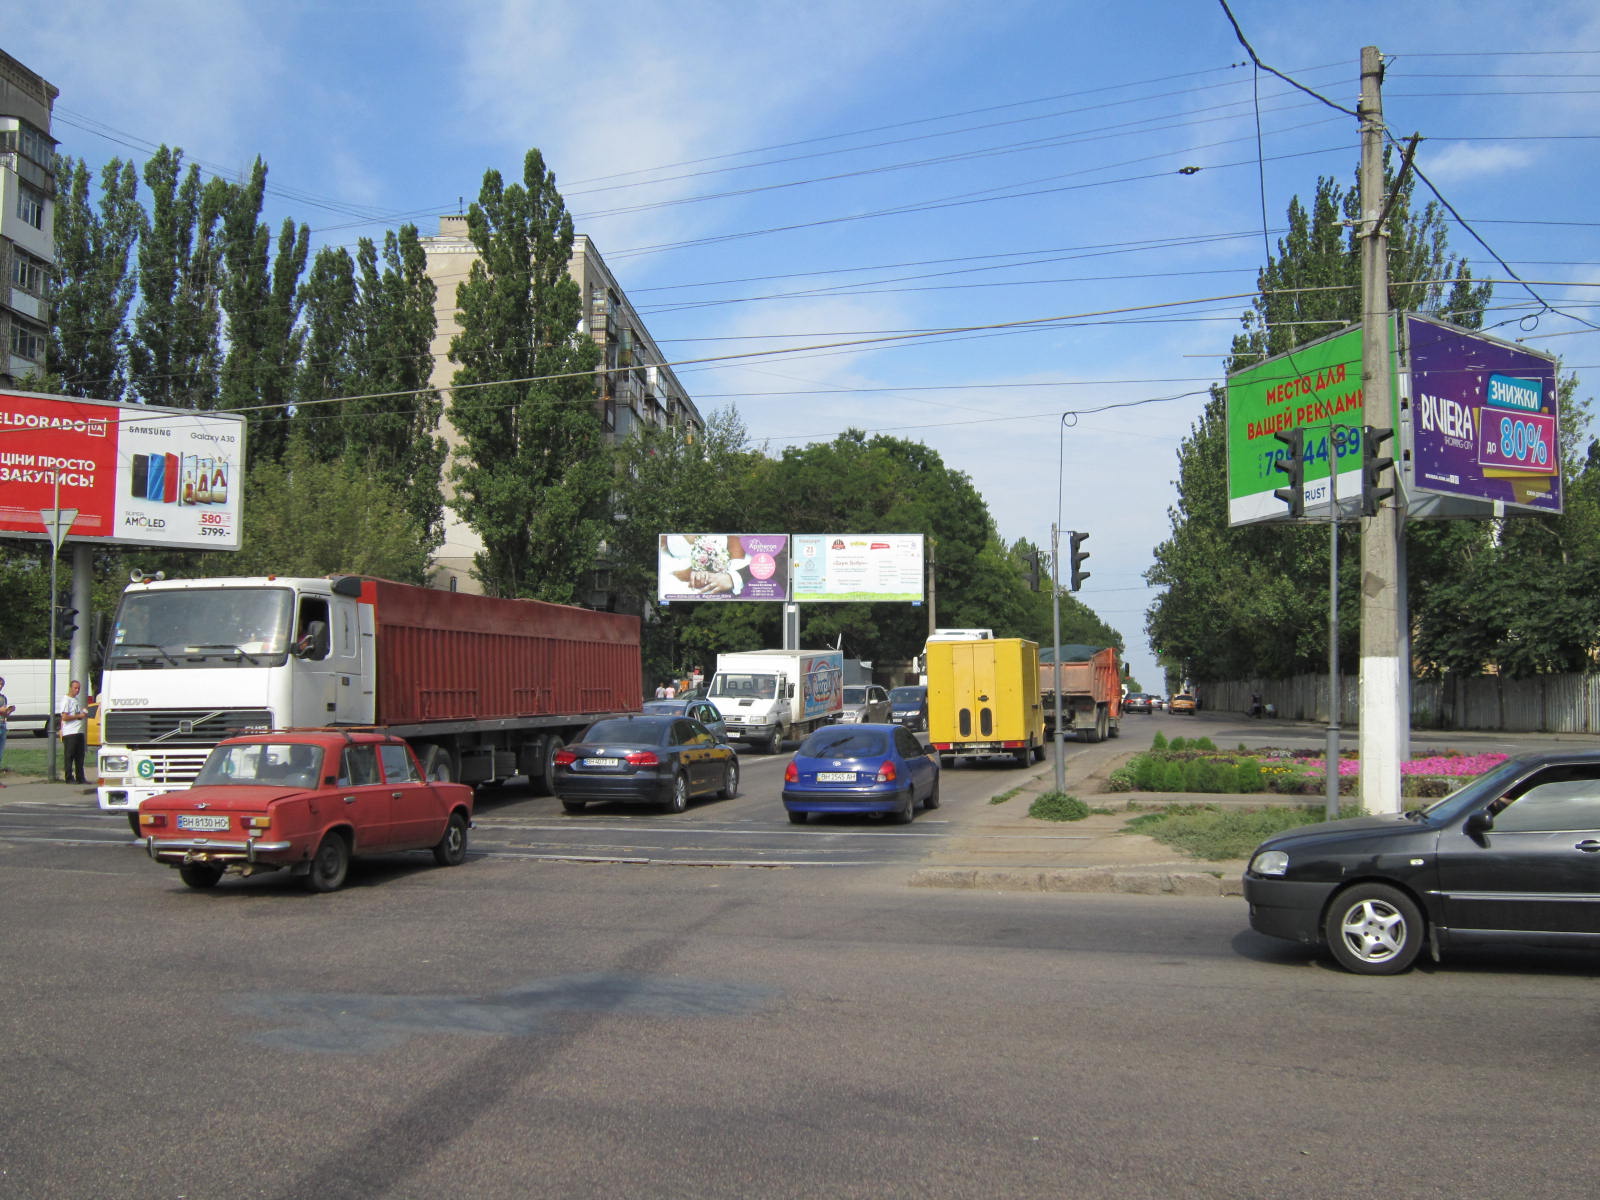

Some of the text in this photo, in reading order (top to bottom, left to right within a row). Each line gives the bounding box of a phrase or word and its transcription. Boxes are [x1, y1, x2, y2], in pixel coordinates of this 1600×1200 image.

[1266, 363, 1346, 405] МЕСТО ДЛЯ
[1491, 381, 1538, 409] ЗНИЖКИ
[0, 412, 86, 432] LDORADO
[1247, 407, 1293, 440] ВАШЕЙ
[1421, 393, 1473, 441] RIVIERA
[129, 426, 171, 437] SAMSUNG
[190, 432, 235, 443] Galaxy A30
[1500, 416, 1547, 465] 80%
[1, 452, 96, 471] ЦІНИ ПРОСТО
[0, 468, 94, 488] ЗАКУПИСЬ!
[125, 516, 166, 528] AMOLED
[201, 514, 222, 524] 580
[111, 698, 149, 706] VOLVO
[141, 763, 151, 774] S
